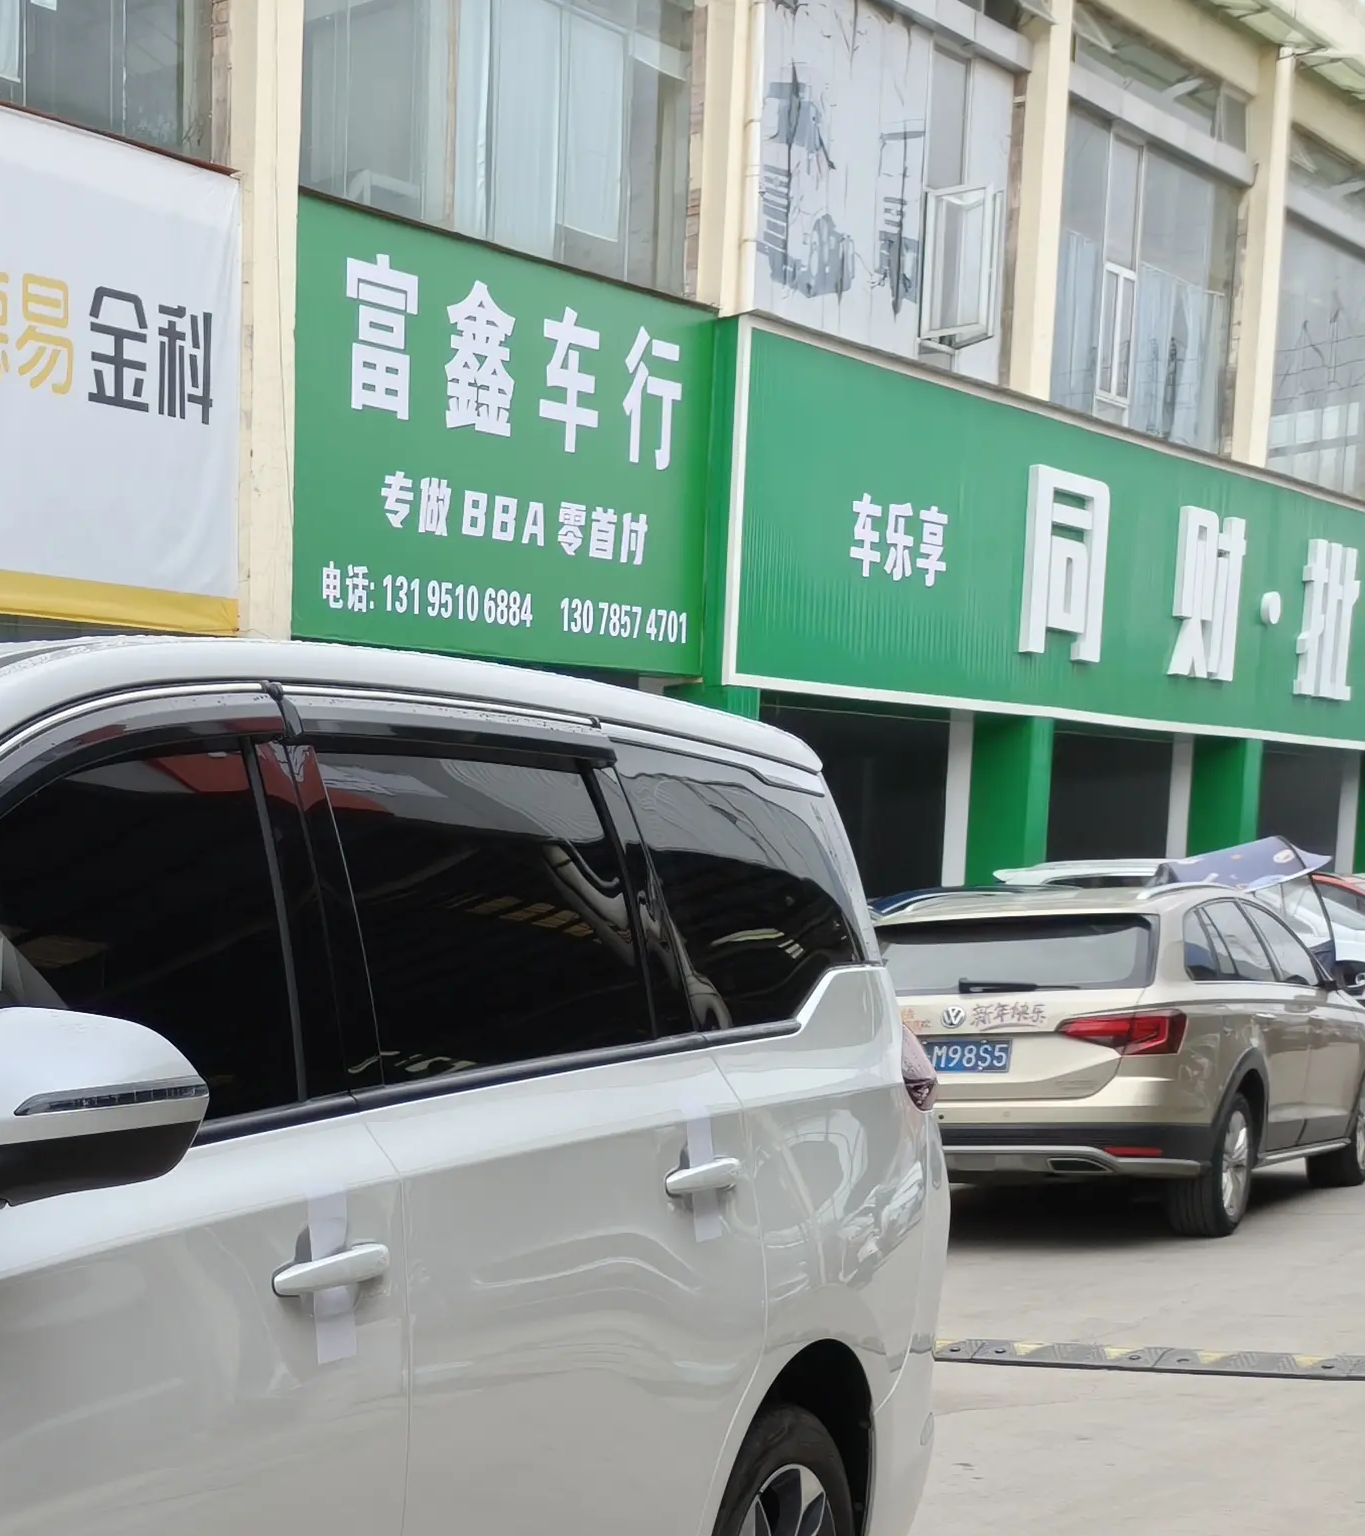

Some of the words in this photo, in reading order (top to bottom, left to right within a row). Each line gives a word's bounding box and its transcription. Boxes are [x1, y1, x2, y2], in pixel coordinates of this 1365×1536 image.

[346, 253, 683, 471] 富鑫车行
[380, 470, 452, 537] 专做
[461, 490, 545, 547] BBA
[557, 501, 649, 565] 零首付
[850, 492, 948, 587] 车乐享
[970, 1001, 1047, 1027] 新年快乐
